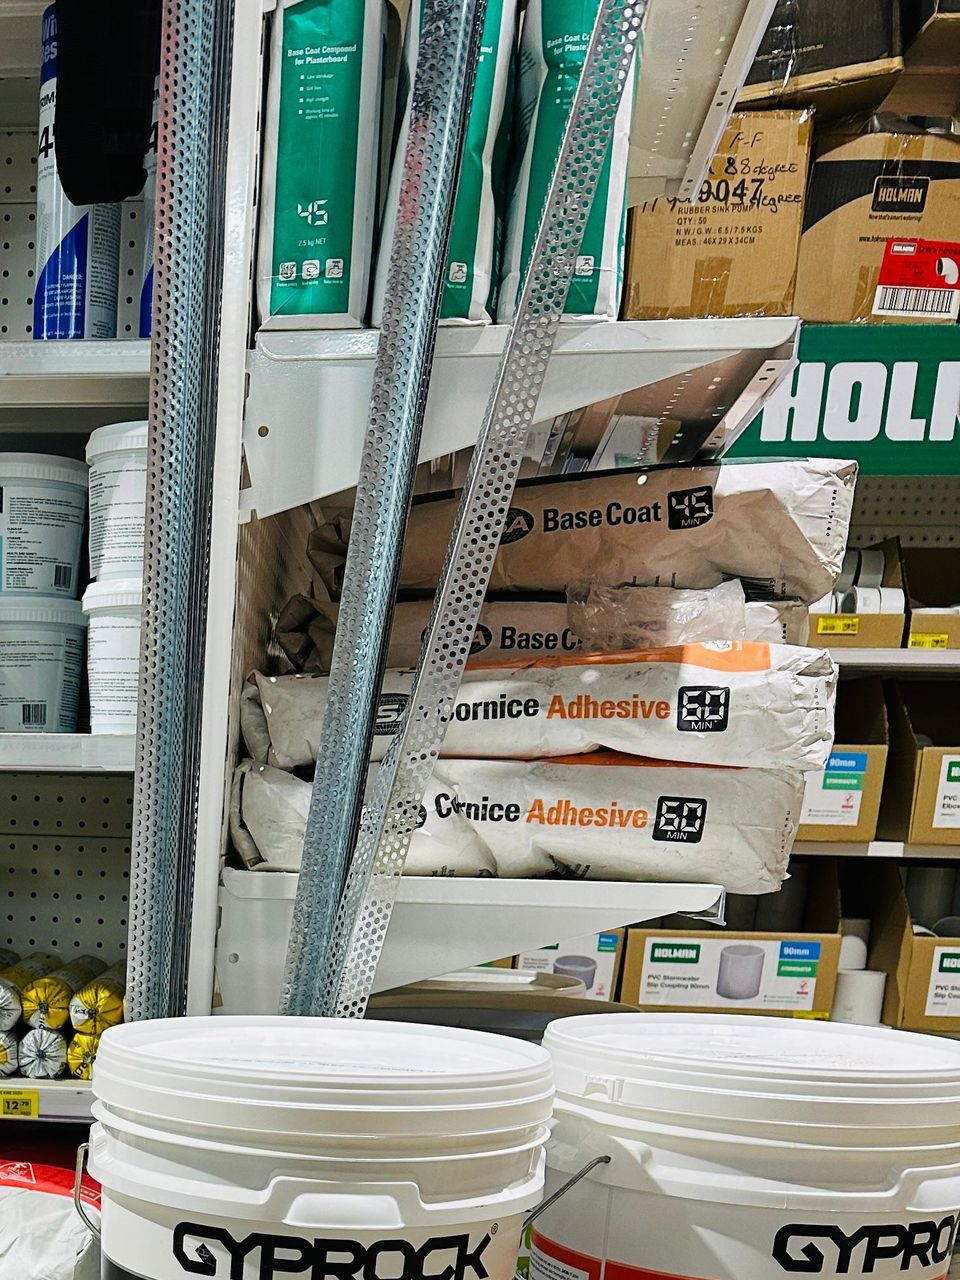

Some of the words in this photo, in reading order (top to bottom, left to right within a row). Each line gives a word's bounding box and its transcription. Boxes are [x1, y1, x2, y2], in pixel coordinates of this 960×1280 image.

[287, 47, 304, 57] Base
[305, 46, 321, 55] Coat
[322, 44, 357, 55] Compound
[294, 57, 304, 65] for
[305, 54, 348, 65] Plasterboard
[878, 187, 923, 203] HOLMAN
[297, 199, 328, 226] 45
[678, 206, 710, 215] RUBBER
[712, 205, 730, 213] SINK
[698, 216, 707, 225] 50
[543, 506, 603, 532] Base
[606, 501, 662, 525] Coat
[681, 517, 701, 527] MIN
[500, 626, 558, 650] Base
[546, 694, 671, 720] Adhesive
[691, 720, 713, 730] MIN
[526, 798, 648, 829] Adhesive
[667, 831, 688, 841] MIN
[772, 1214, 955, 1273] GYPRO
